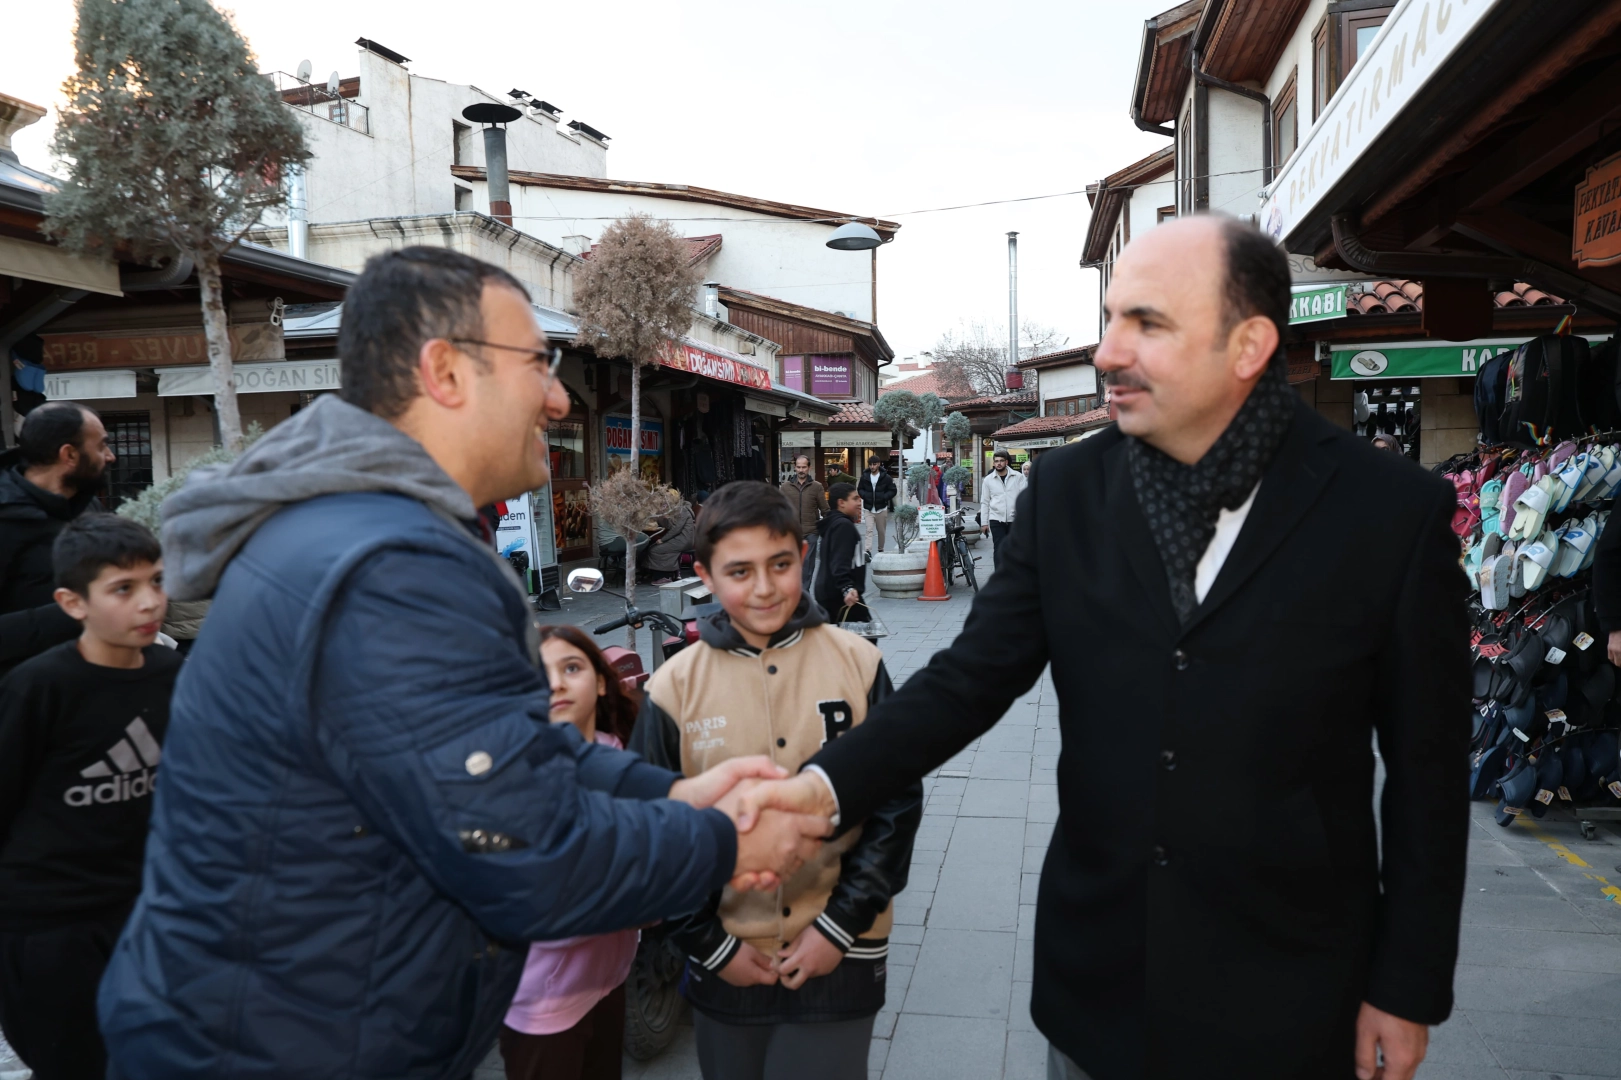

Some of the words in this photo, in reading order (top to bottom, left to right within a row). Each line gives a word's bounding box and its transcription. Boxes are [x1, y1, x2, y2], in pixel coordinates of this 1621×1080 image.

[1578, 176, 1621, 217] PEKYAT
[1584, 209, 1621, 245] KAVA
[685, 716, 727, 734] PARIS
